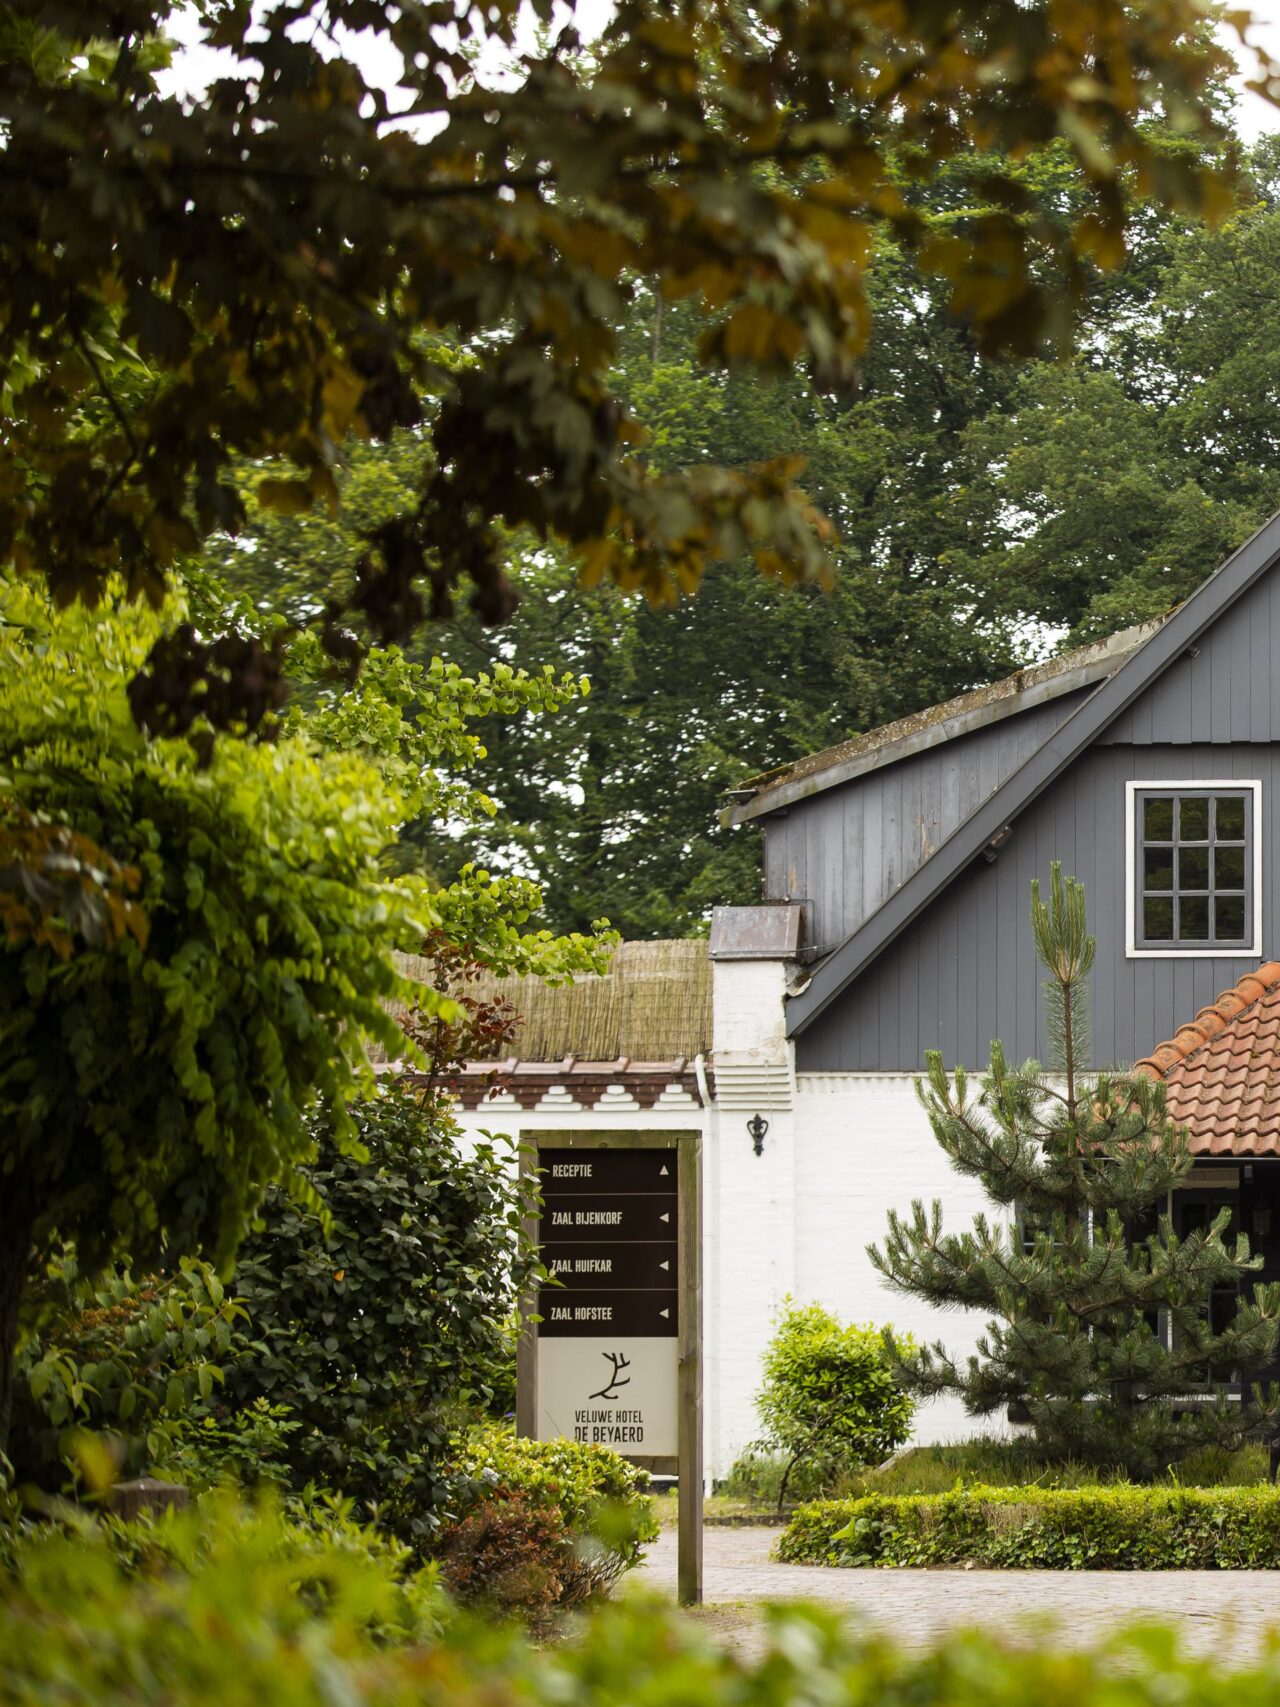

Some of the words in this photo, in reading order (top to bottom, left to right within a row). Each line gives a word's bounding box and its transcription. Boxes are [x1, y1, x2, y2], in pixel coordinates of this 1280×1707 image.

[552, 1164, 592, 1177] RECEPTIE
[551, 1212, 574, 1225] ZAAL
[575, 1211, 623, 1225] BIJENKORF
[551, 1259, 573, 1273] ZAAL
[575, 1259, 612, 1272] HUIFKAR
[550, 1307, 573, 1321] ZAAL
[574, 1307, 613, 1320] HOFSTEE
[574, 1410, 612, 1423] VELUWE
[616, 1410, 644, 1423] HOTEL
[574, 1426, 588, 1442] DE
[592, 1426, 644, 1442] BEYAERD
